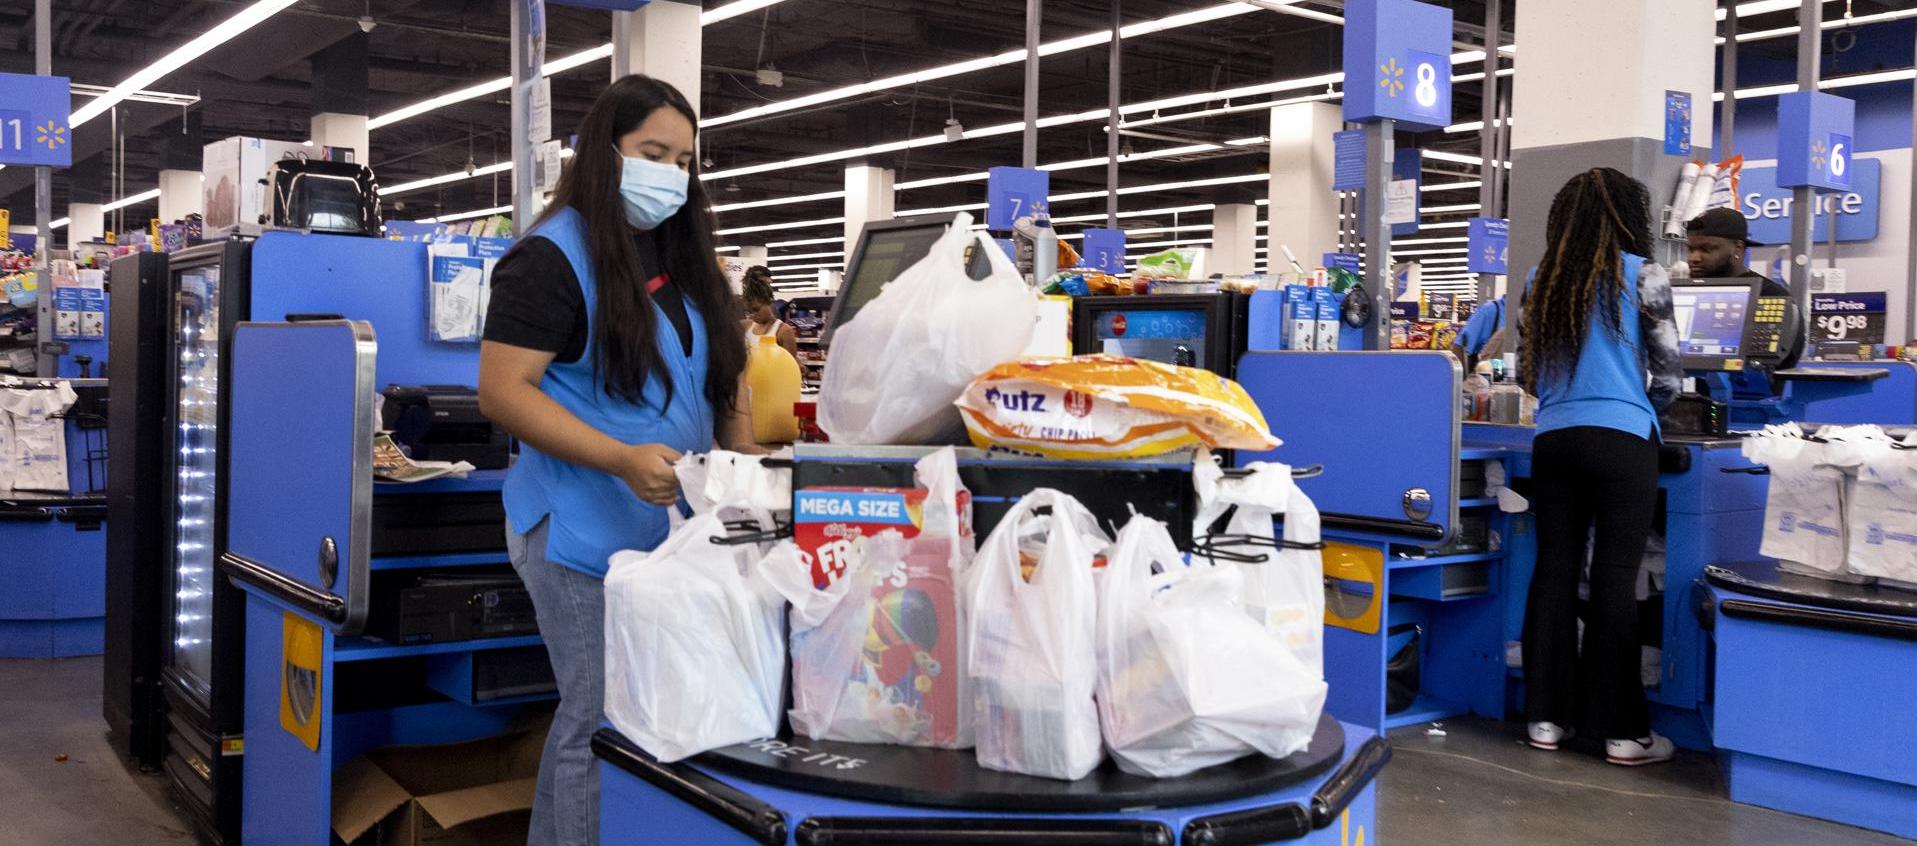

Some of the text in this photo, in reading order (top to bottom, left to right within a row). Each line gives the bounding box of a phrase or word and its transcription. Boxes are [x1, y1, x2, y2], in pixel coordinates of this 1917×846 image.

[1415, 62, 1437, 108] 8
[1830, 143, 1845, 177] 6
[1010, 198, 1022, 221] 7
[1744, 191, 1863, 220] Serice
[1100, 251, 1108, 268] 3
[1814, 301, 1866, 311] Low Price
[1041, 427, 1064, 440] CHIP
[800, 497, 900, 518] MEGA SIZE
